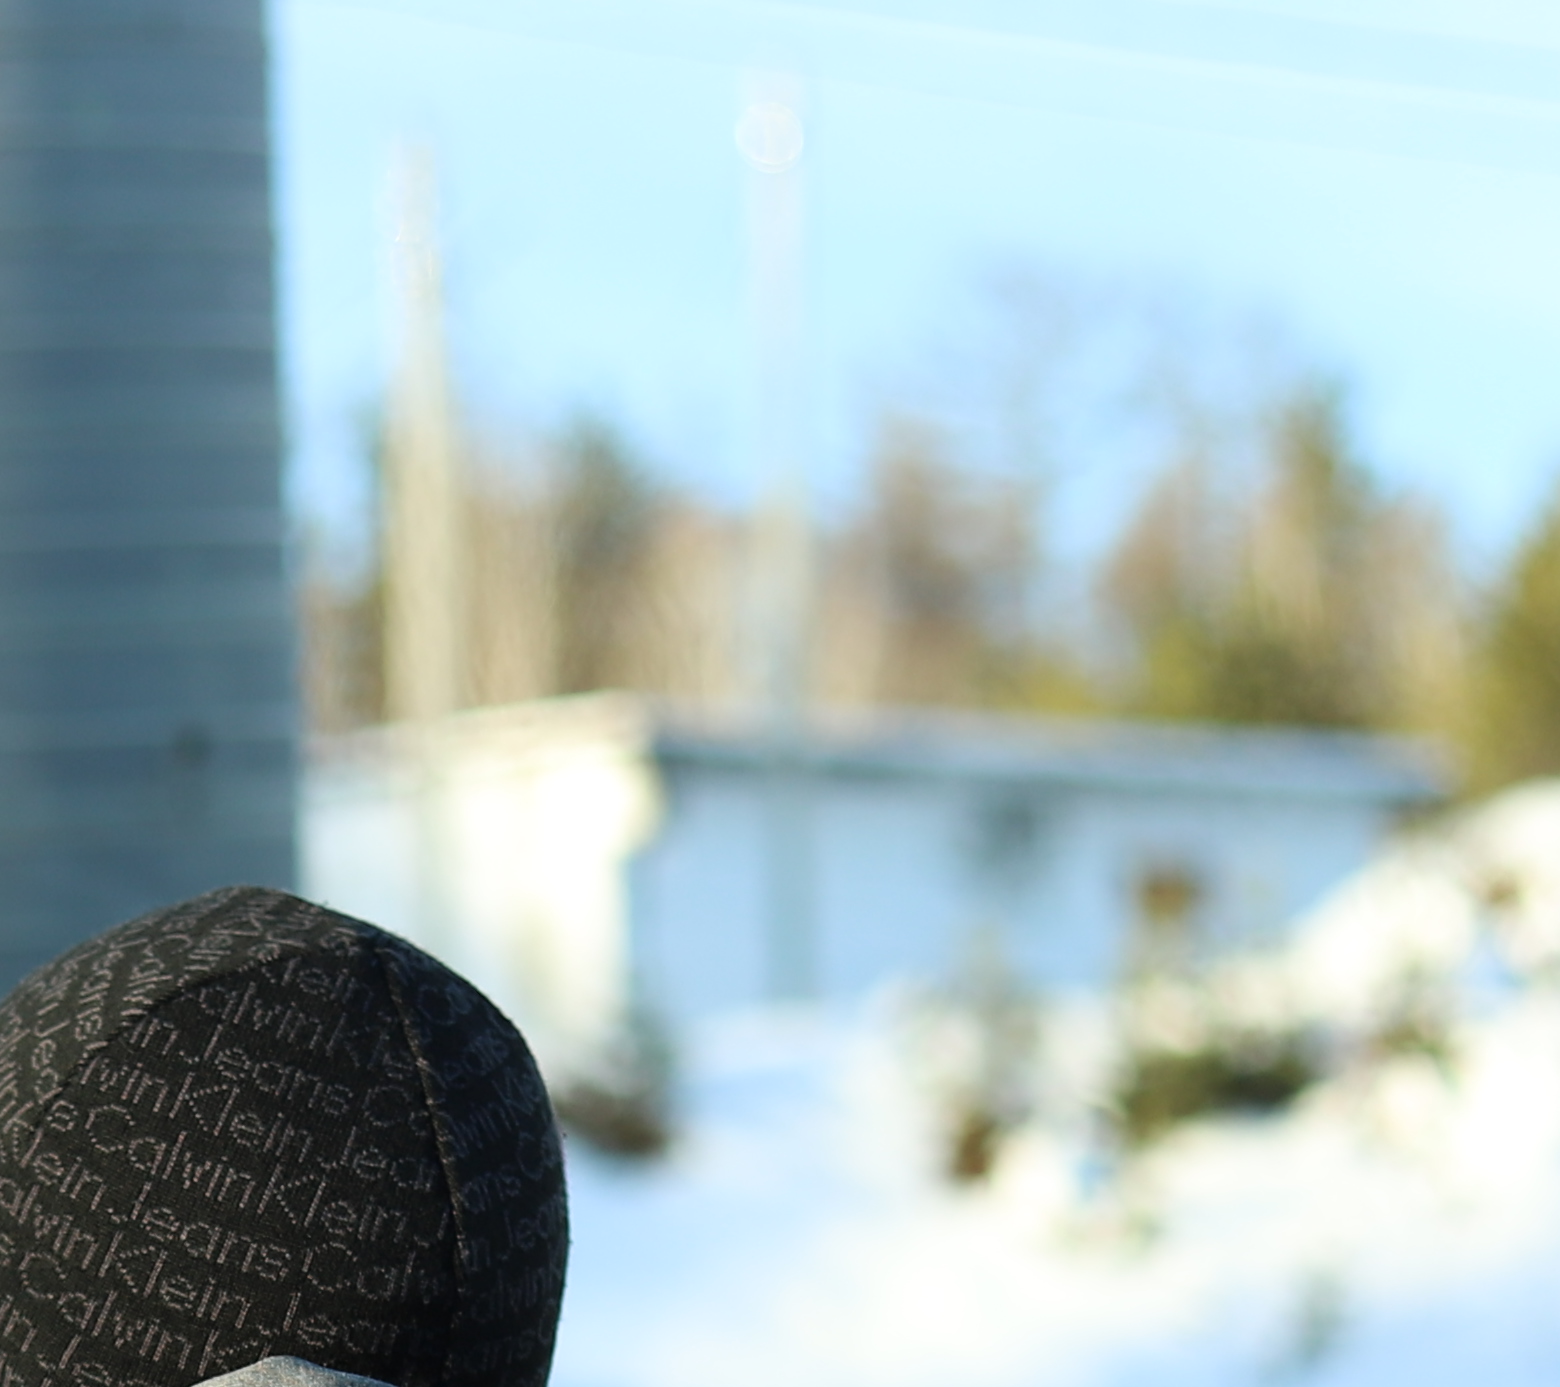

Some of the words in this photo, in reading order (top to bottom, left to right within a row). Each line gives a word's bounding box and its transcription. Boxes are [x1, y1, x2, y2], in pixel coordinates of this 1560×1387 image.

[76, 1095, 264, 1213] Calvin
[167, 1068, 320, 1172] Klein
[96, 1228, 259, 1334] Klein
[104, 1179, 295, 1285] Jeans
[18, 1250, 193, 1371] Calvin
